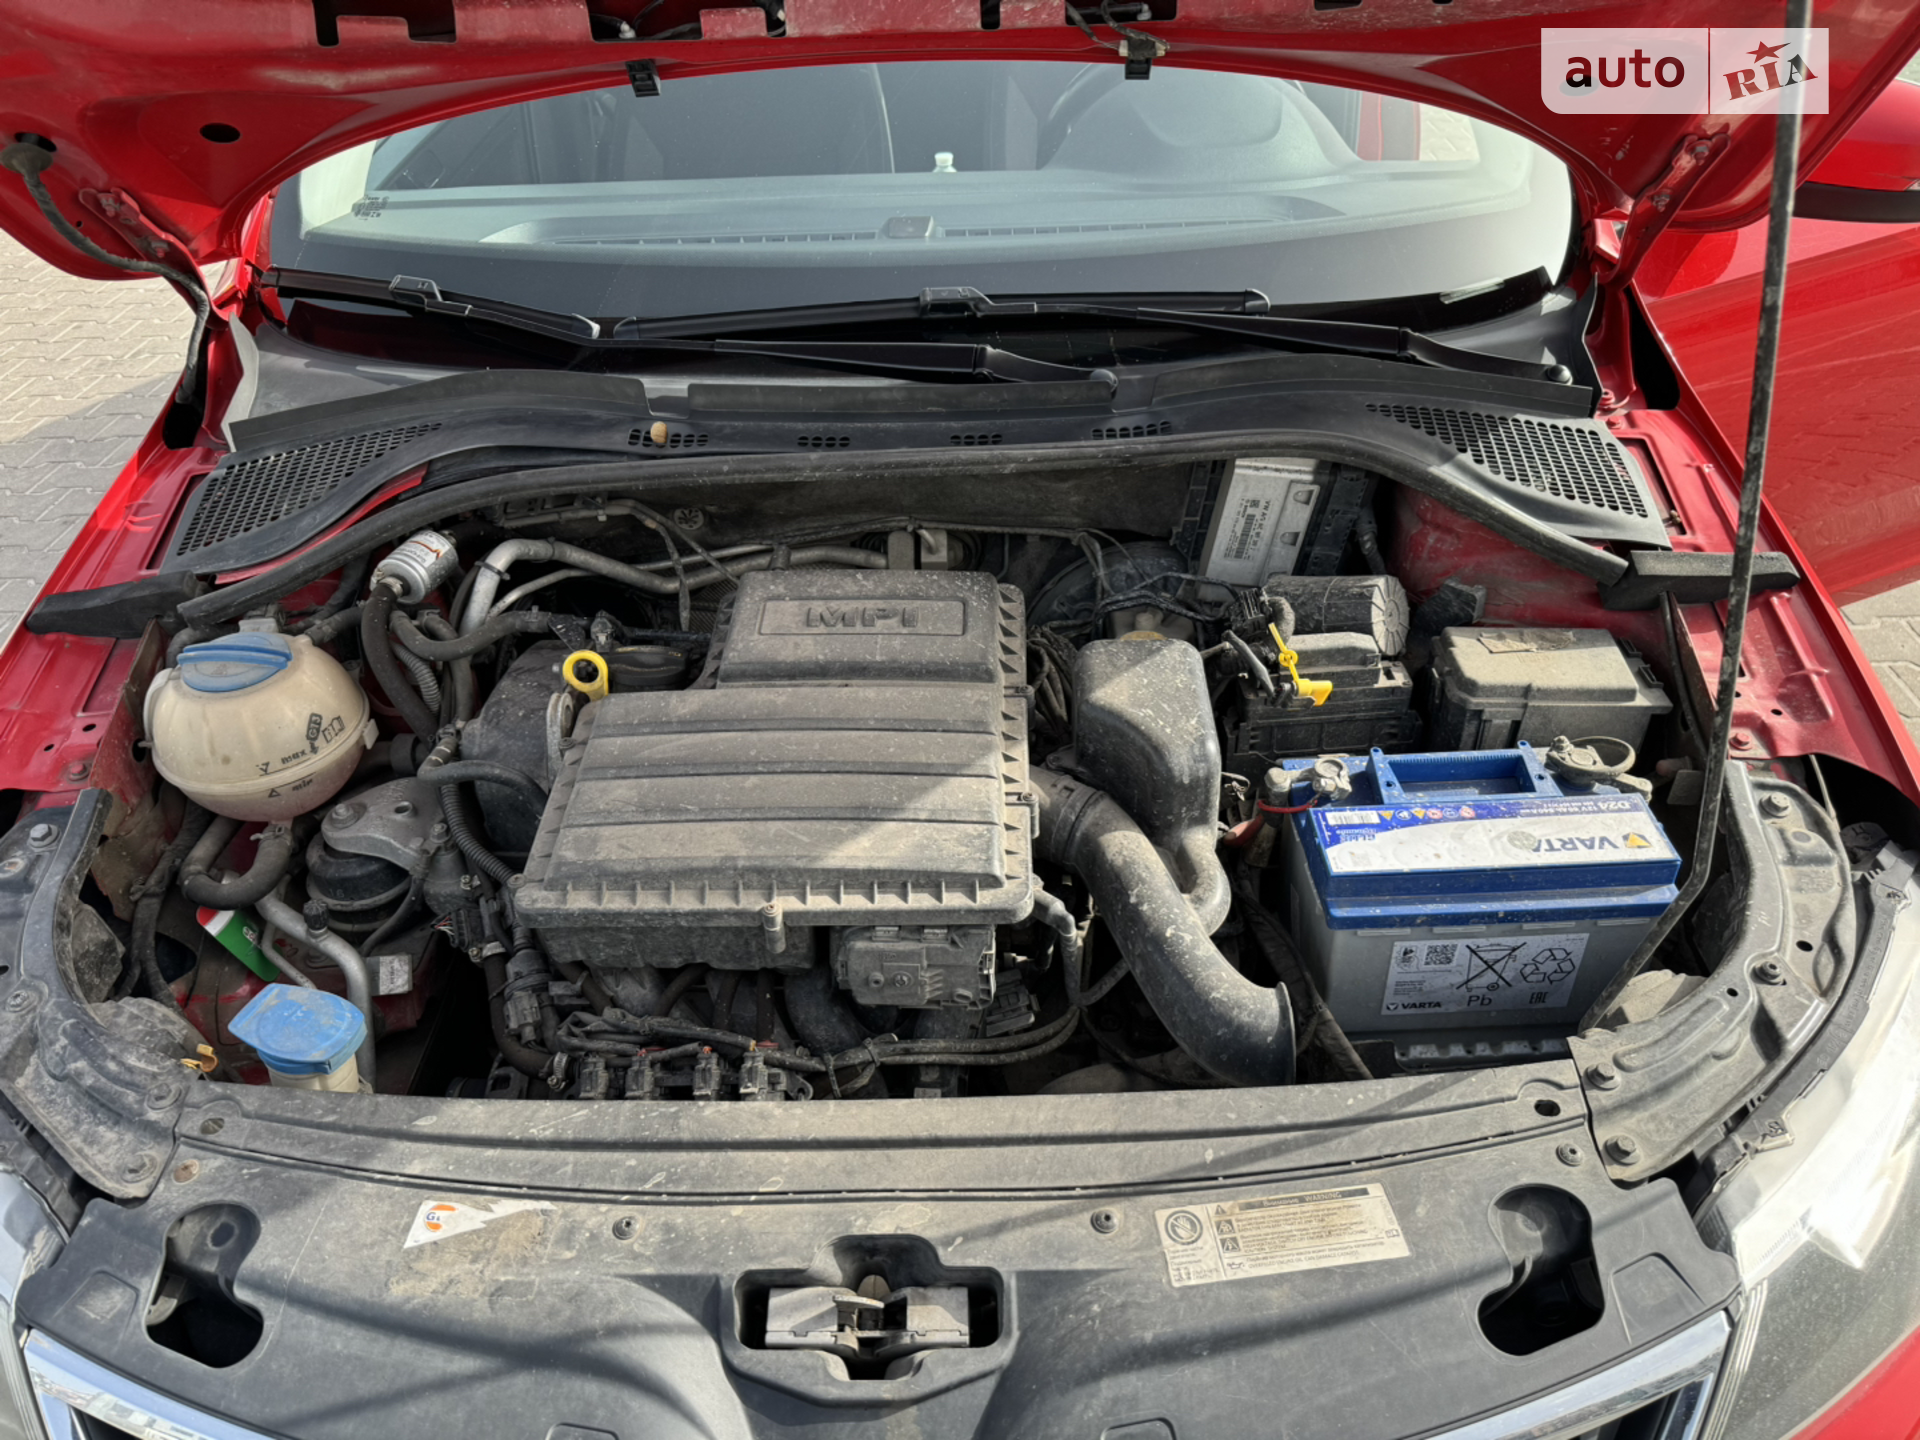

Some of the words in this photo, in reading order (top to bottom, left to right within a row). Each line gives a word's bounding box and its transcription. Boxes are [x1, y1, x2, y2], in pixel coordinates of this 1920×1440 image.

[806, 606, 919, 628] MPI
[281, 749, 307, 764] max
[1597, 801, 1631, 811] D24
[1402, 1001, 1442, 1009] VARTA
[1467, 995, 1492, 1007] Pb
[1304, 1192, 1342, 1202] WARNING
